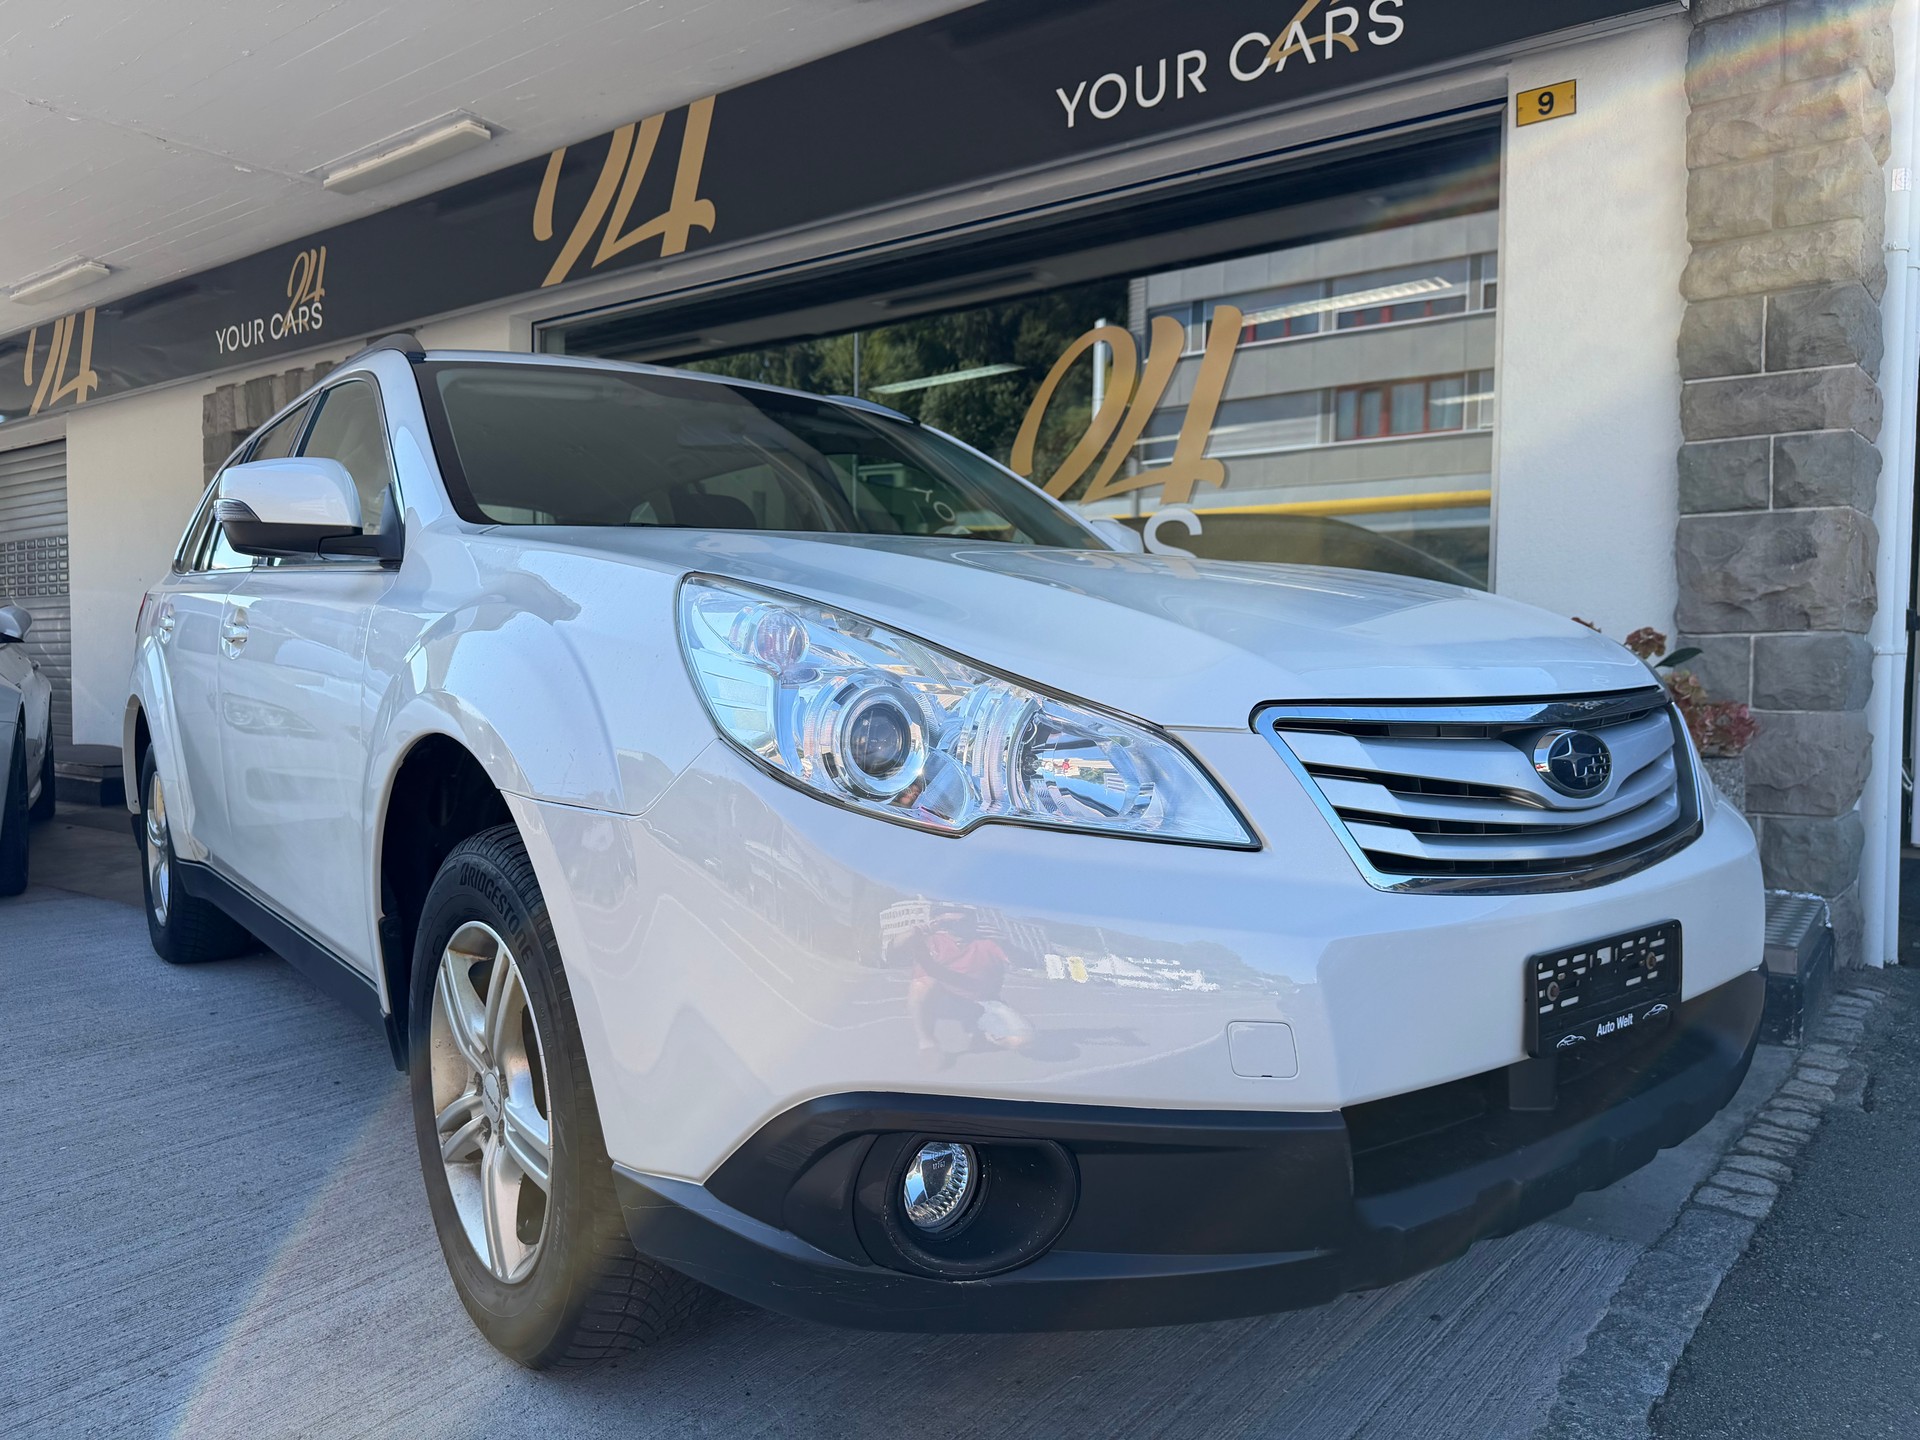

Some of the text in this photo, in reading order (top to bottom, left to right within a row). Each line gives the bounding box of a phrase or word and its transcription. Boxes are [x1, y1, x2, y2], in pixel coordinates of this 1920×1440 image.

[1056, 0, 1405, 128] YOUR CARS
[1538, 91, 1554, 116] 9
[215, 301, 323, 354] YOUR CARS
[458, 862, 534, 965] BRIDGESTONE
[1596, 1012, 1634, 1037] Auto Welt
